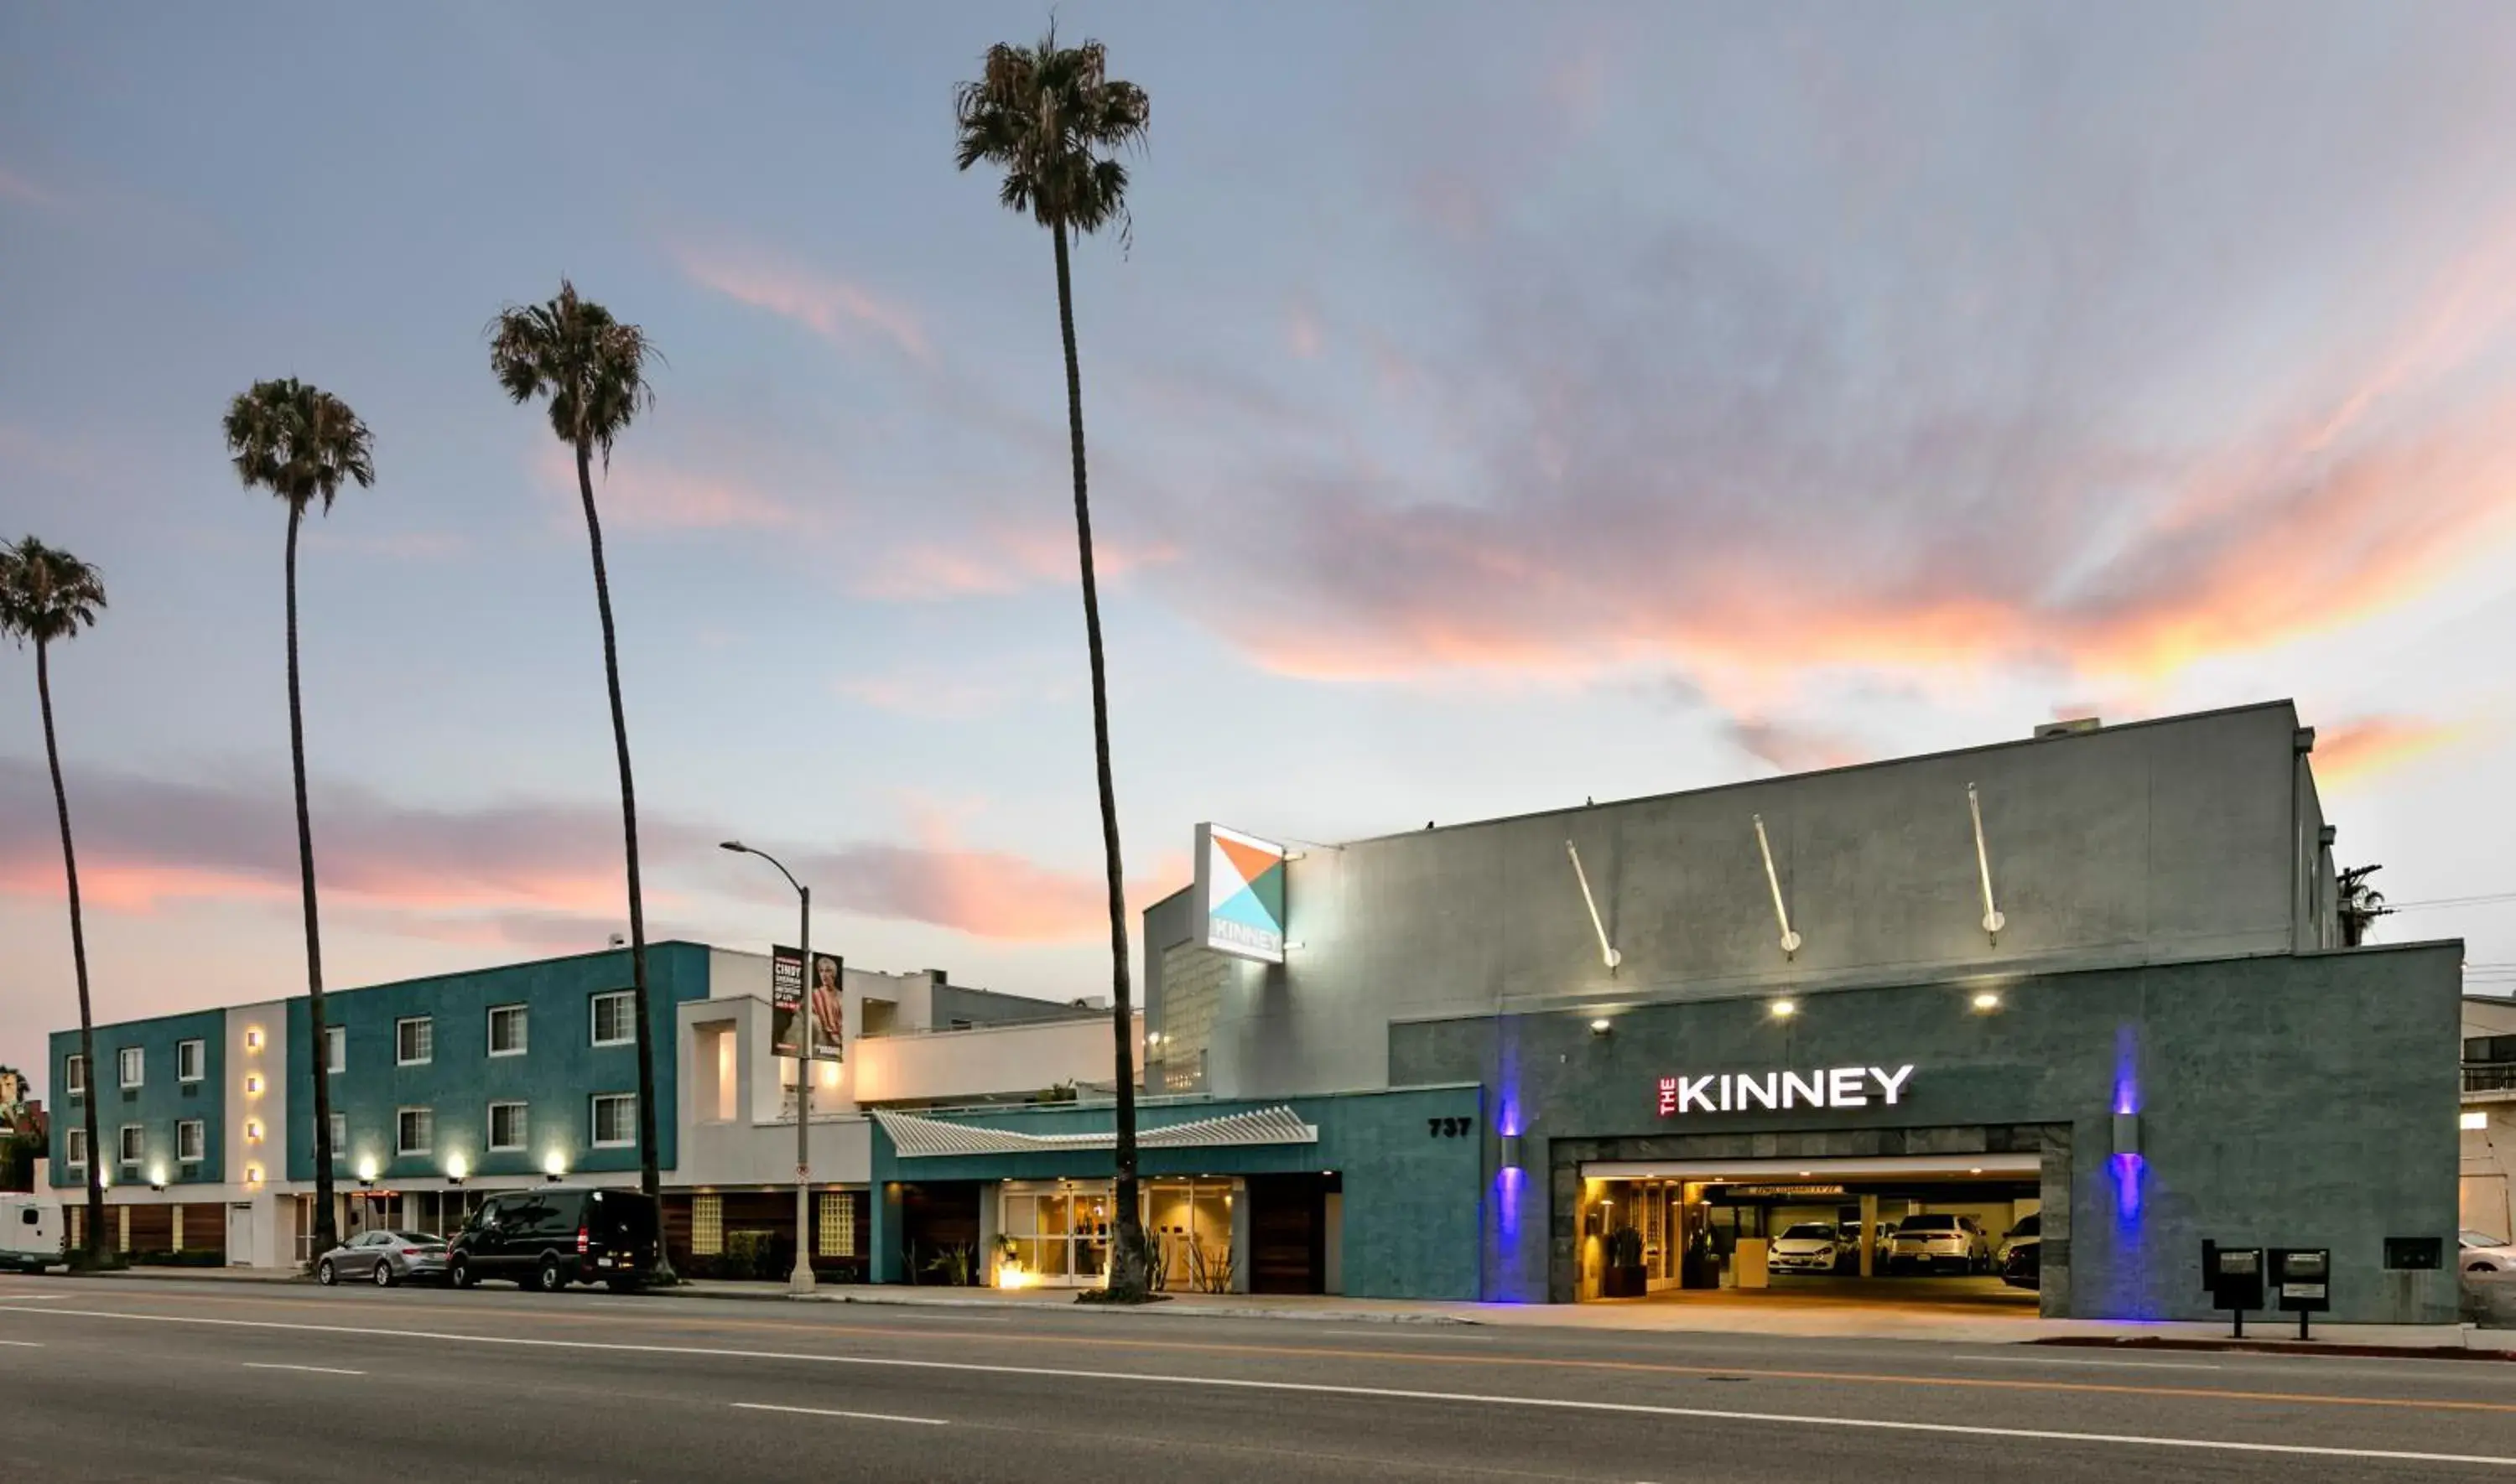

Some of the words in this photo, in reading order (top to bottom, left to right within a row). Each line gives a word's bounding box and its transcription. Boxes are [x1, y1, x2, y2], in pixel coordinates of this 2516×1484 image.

[1216, 918, 1280, 952] KINNEY
[775, 963, 801, 978] CINDY
[1660, 1077, 1676, 1116] THE
[1678, 1064, 1915, 1113] KINNEY
[1427, 1117, 1473, 1139] 737
